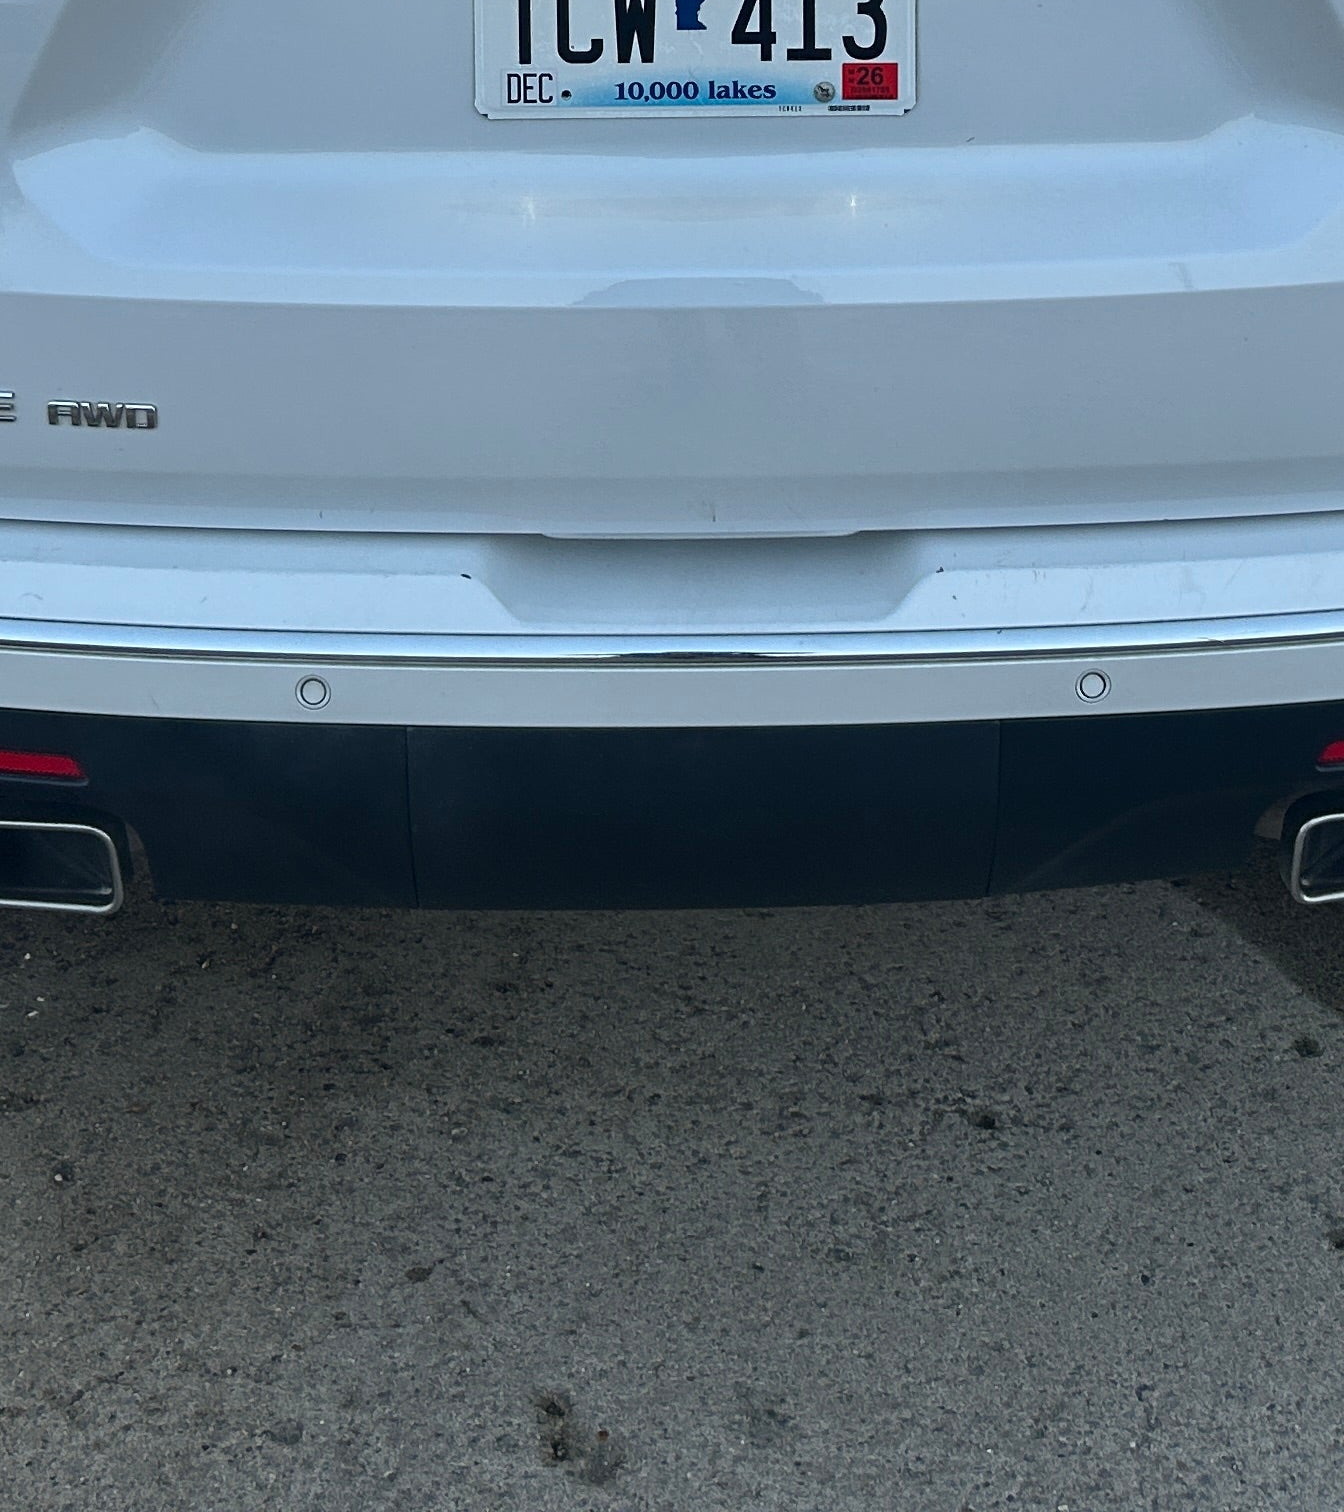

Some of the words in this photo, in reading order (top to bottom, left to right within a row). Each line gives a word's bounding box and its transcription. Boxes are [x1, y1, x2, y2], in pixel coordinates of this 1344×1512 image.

[506, 72, 554, 104] DEC
[857, 66, 884, 86] 26
[614, 81, 700, 103] 10,000
[708, 80, 777, 100] lakes
[47, 400, 158, 429] AWD
